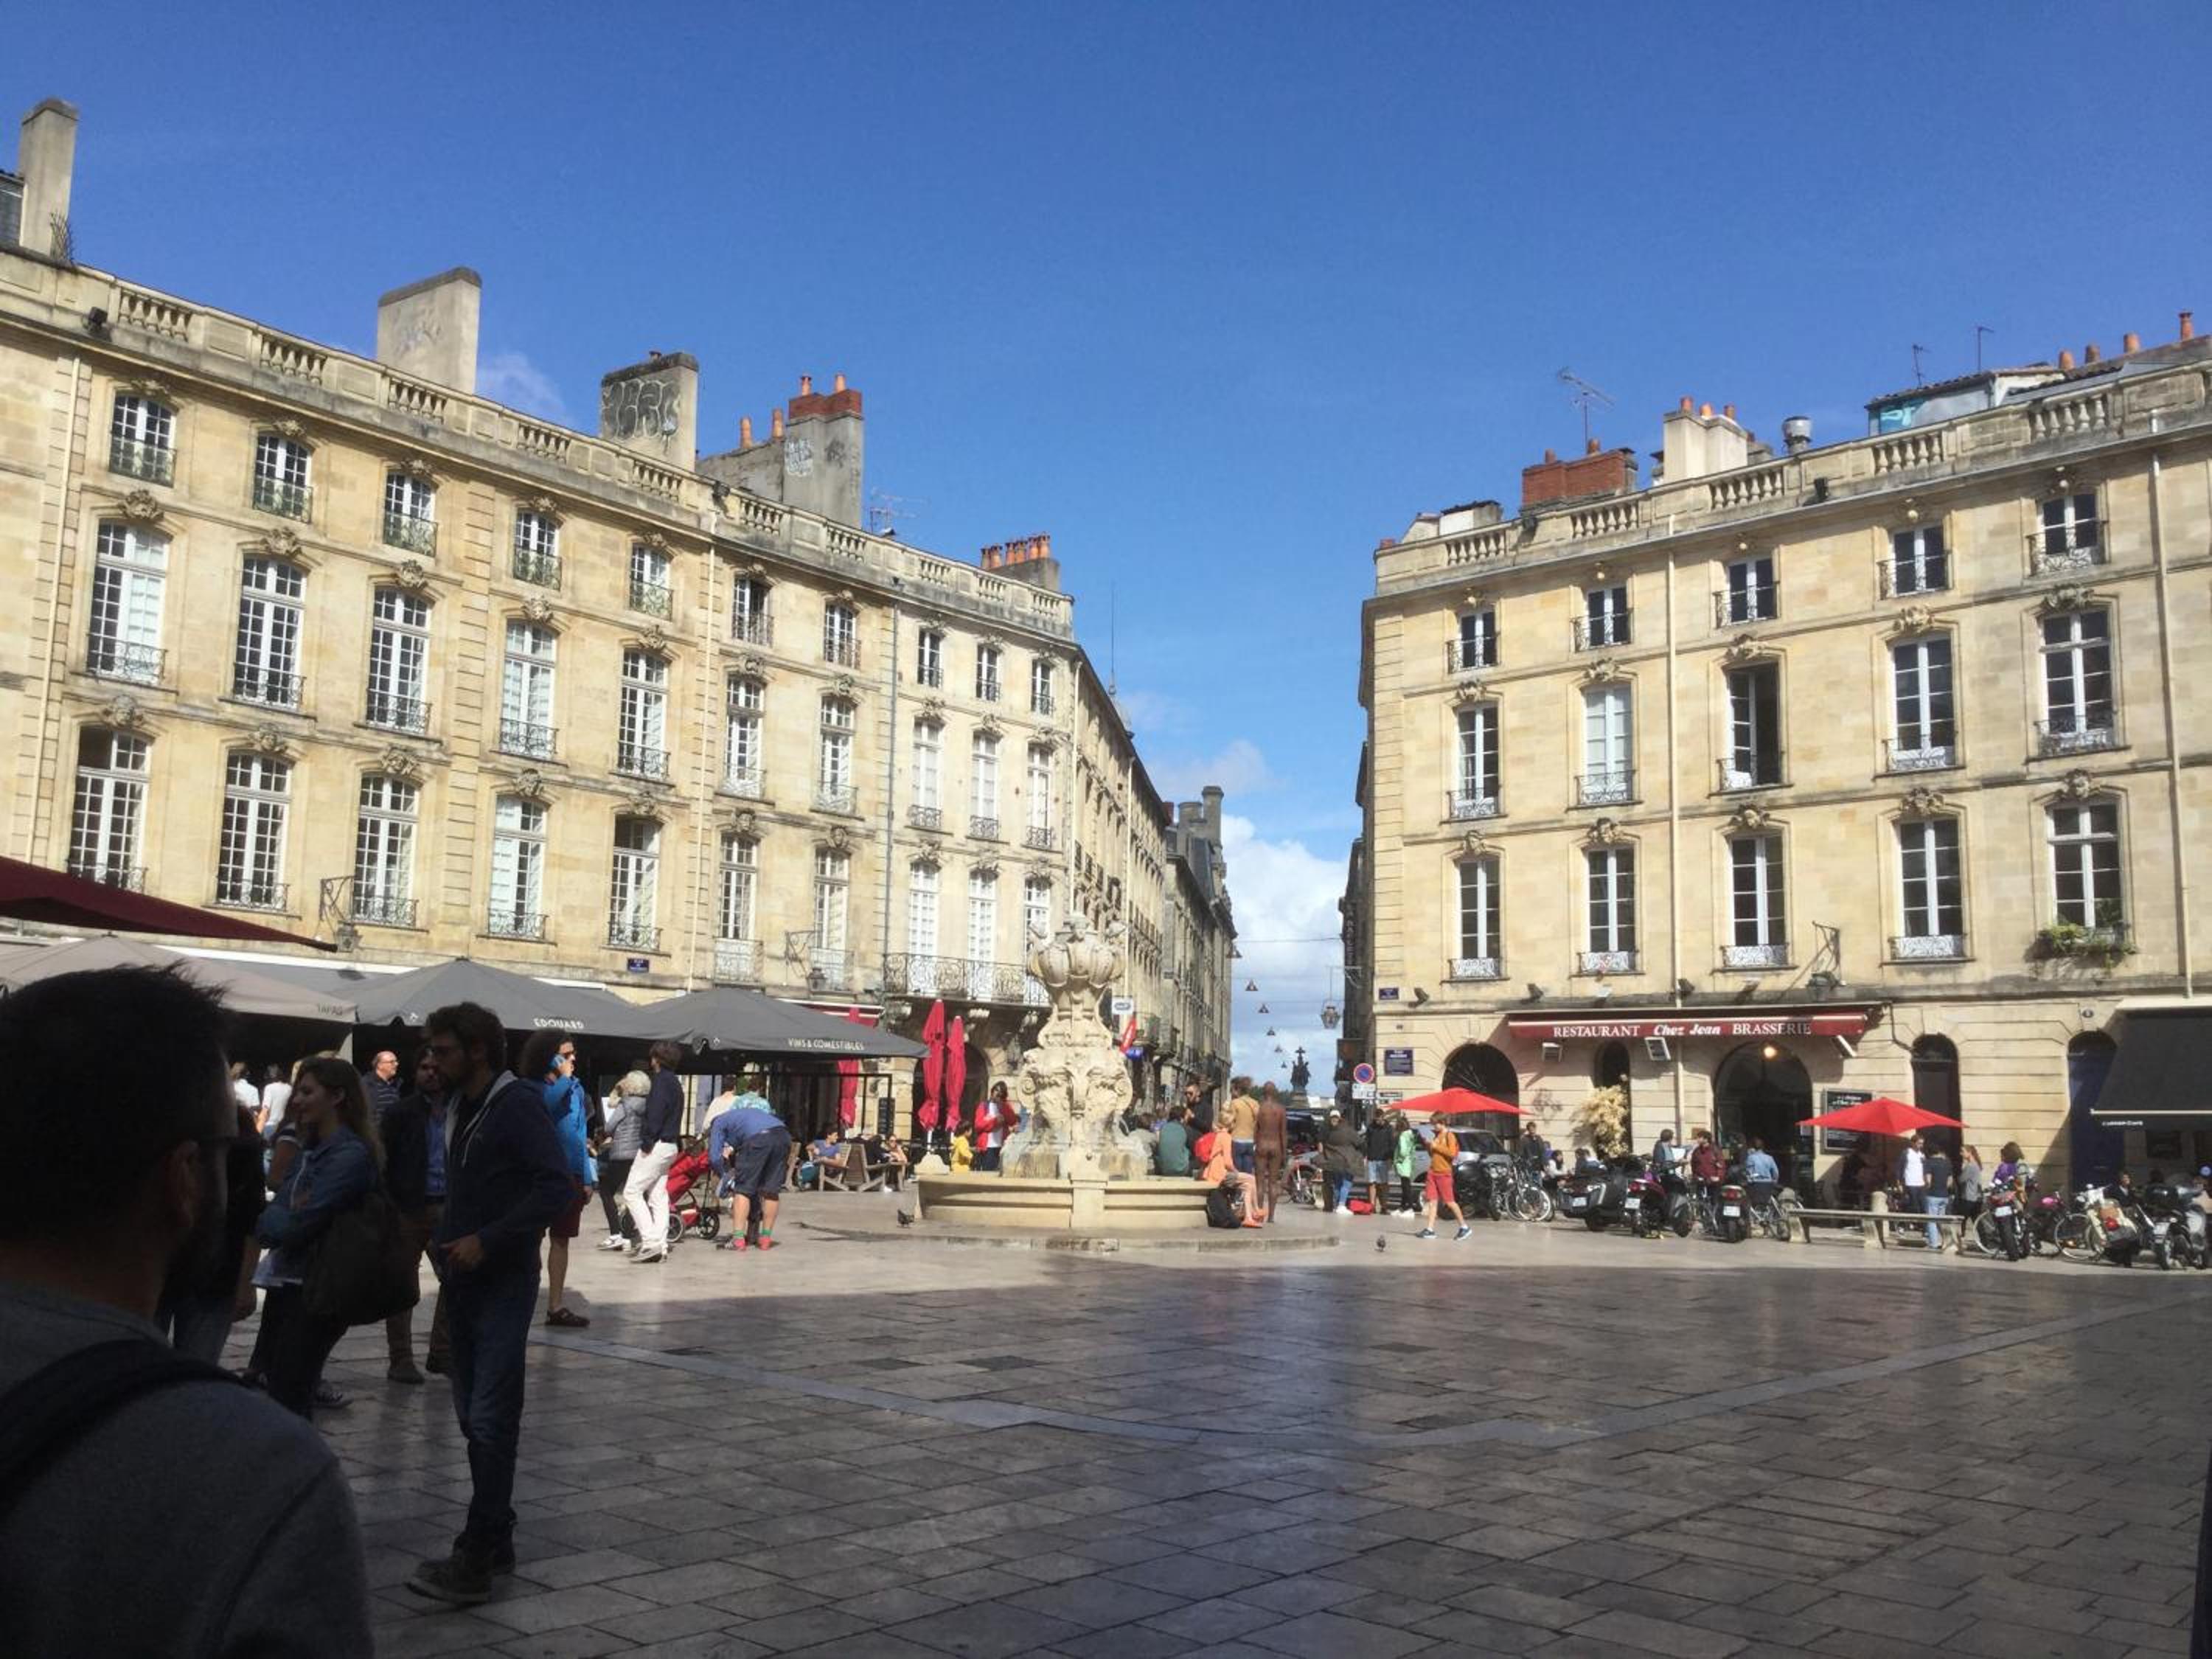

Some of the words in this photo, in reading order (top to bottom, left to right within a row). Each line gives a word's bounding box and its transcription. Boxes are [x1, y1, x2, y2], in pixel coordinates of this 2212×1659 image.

[1553, 1025, 1641, 1037] RESTAURANT
[1652, 1024, 1686, 1036] Chez
[1689, 1023, 1721, 1035] Jean
[1732, 1023, 1812, 1035] BRASSERIE
